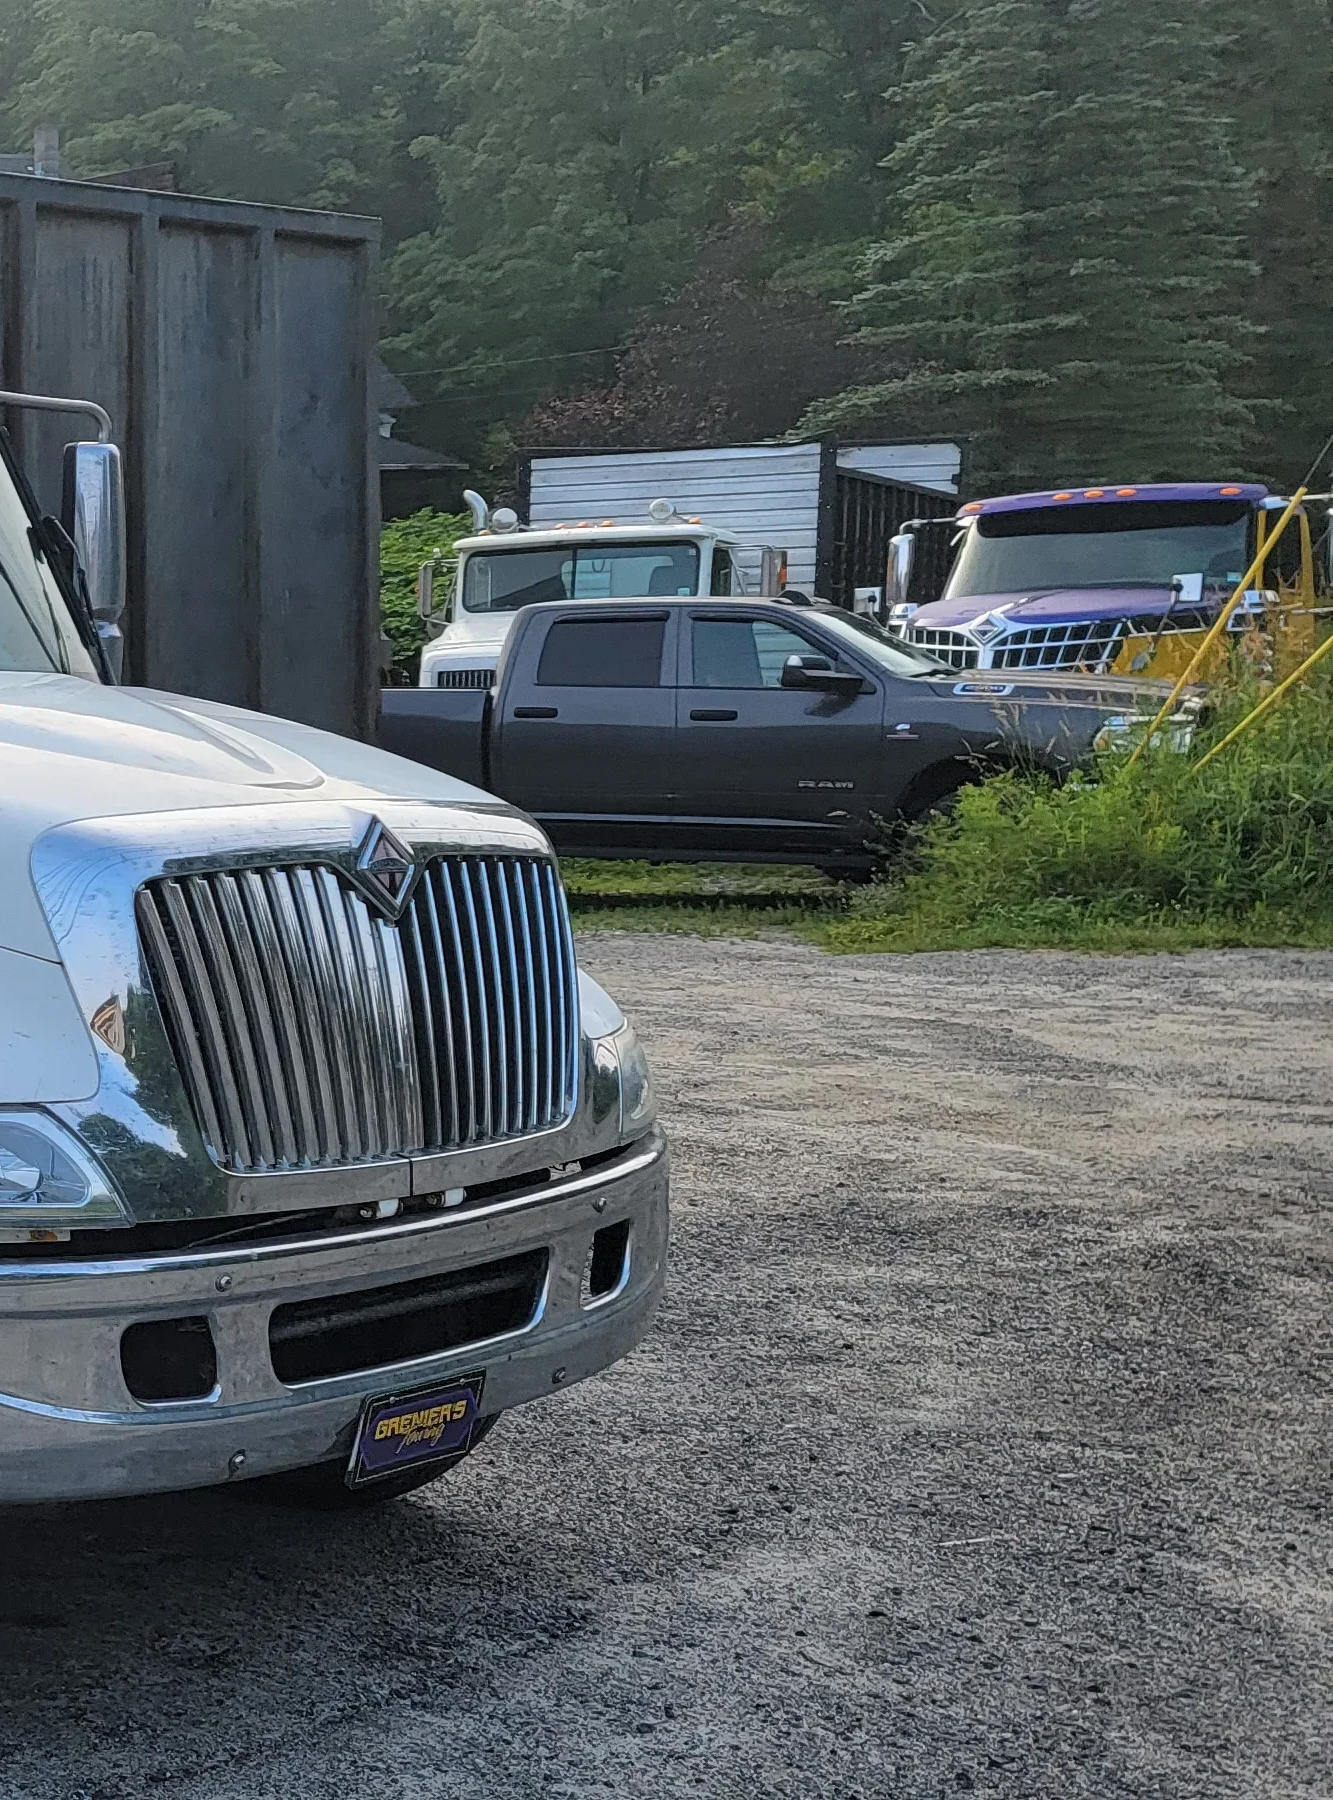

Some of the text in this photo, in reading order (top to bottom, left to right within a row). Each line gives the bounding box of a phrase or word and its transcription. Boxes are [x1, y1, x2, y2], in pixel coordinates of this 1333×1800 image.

[798, 780, 854, 788] RAM
[375, 1400, 467, 1440] GRENIER'S
[395, 1422, 446, 1454] Towing
